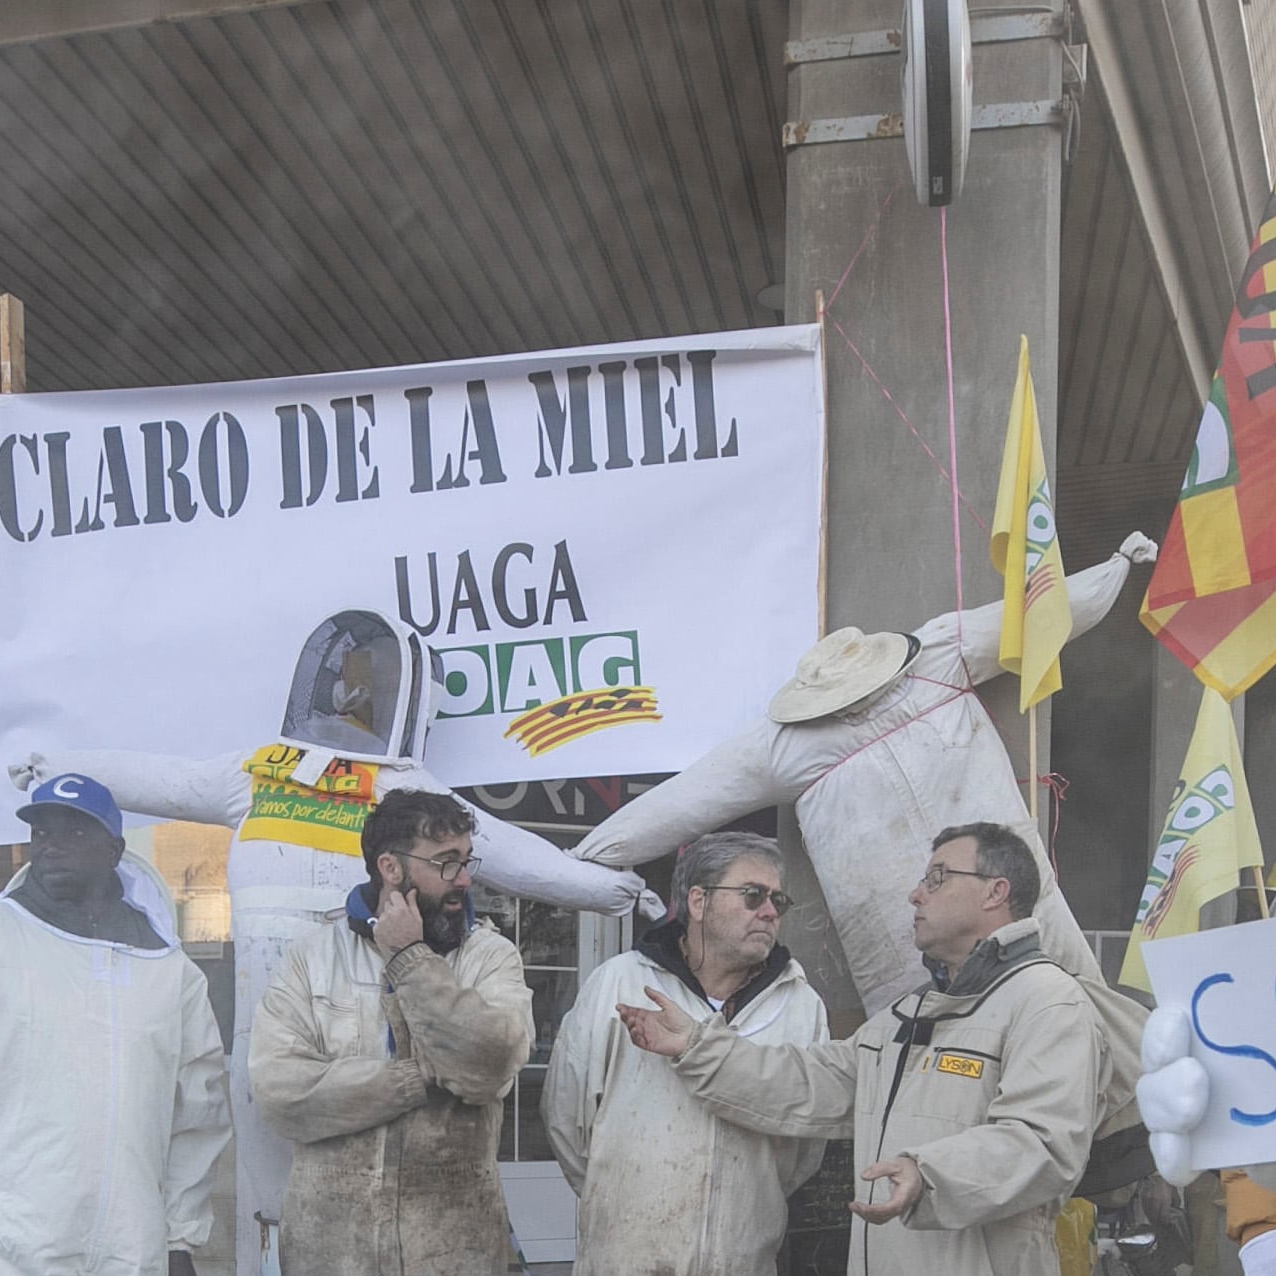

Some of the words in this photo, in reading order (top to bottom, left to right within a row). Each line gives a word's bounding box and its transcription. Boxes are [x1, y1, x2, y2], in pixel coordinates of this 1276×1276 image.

[275, 393, 381, 509] DE
[403, 379, 508, 494] LA
[528, 350, 739, 479] MIEL
[394, 538, 589, 637] UAGA
